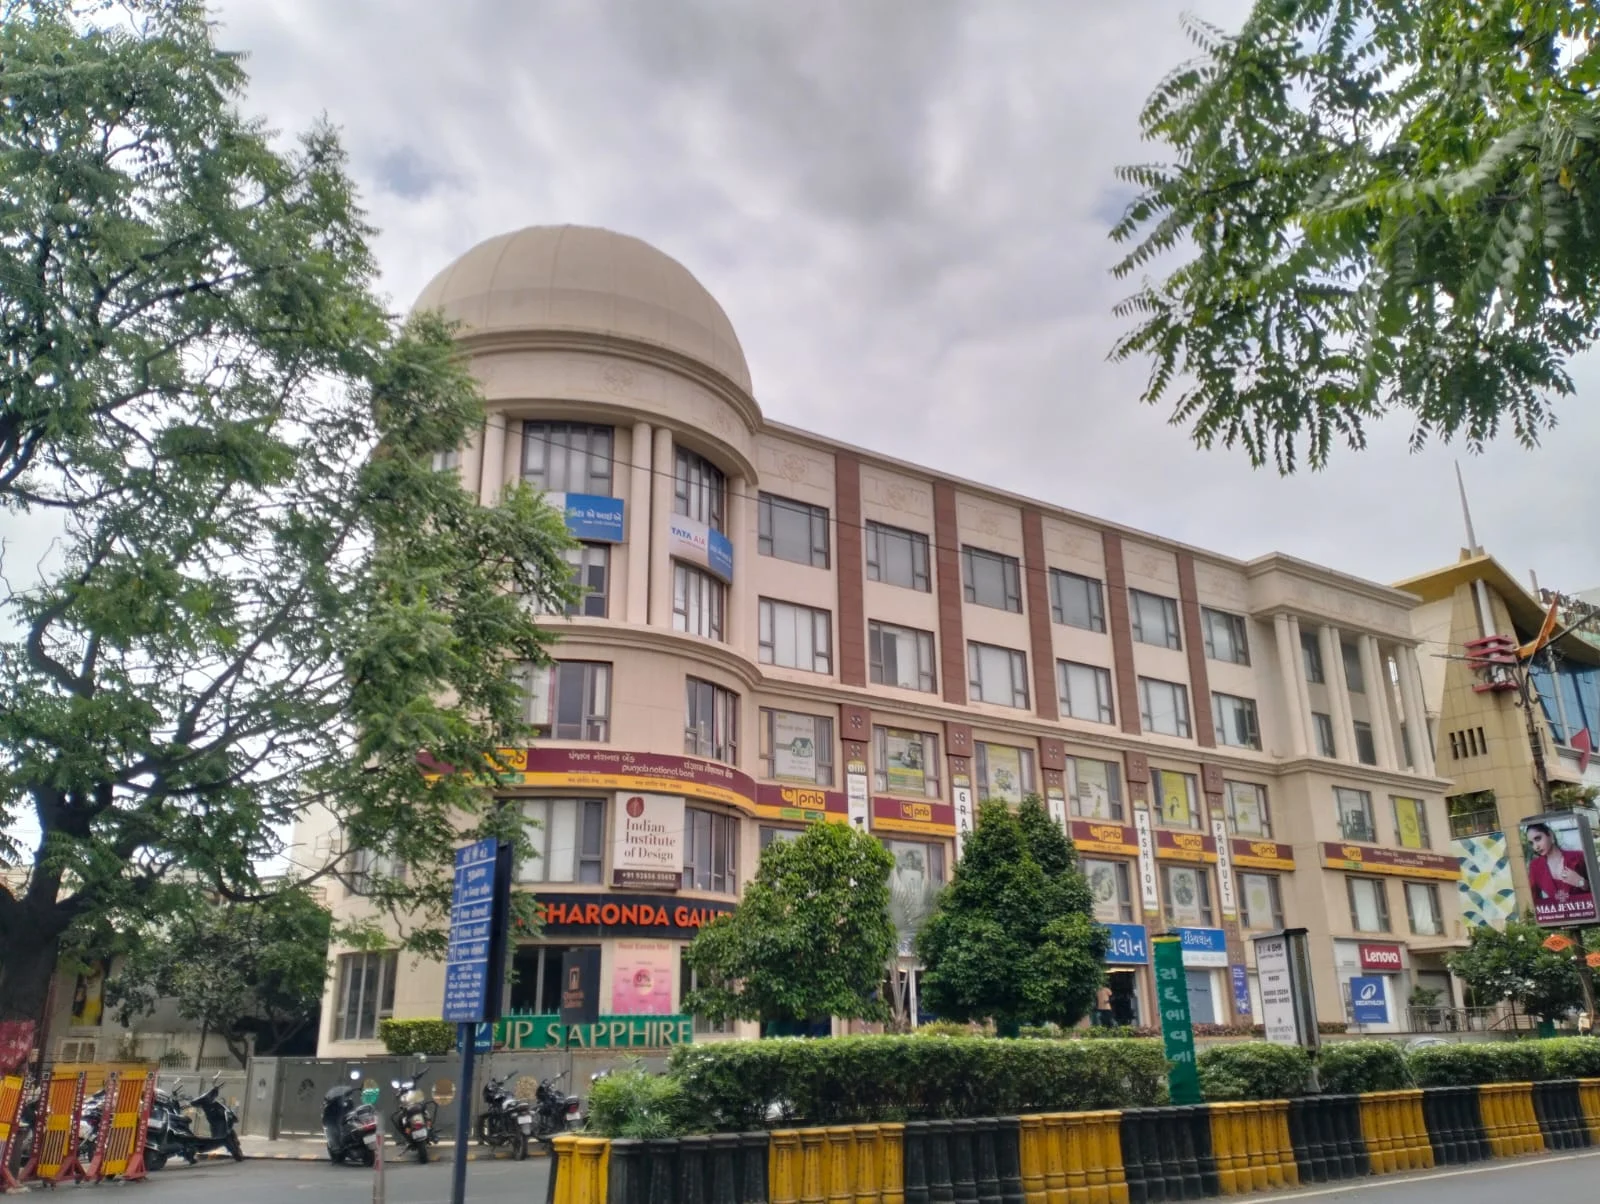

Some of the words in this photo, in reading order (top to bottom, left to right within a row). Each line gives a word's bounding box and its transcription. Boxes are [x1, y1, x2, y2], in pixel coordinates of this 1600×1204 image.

[671, 526, 692, 541] TATA
[621, 763, 649, 775] punjab
[650, 765, 678, 776] national
[679, 768, 695, 779] bank
[799, 791, 824, 806] pnb
[914, 804, 930, 817] pnb
[626, 818, 665, 833] Indian
[625, 831, 676, 846] Institute
[1103, 829, 1121, 840] pnb
[1185, 837, 1201, 848] pnb
[624, 846, 635, 858] of
[638, 847, 674, 863] Design
[1139, 814, 1153, 896] FASHION
[1261, 846, 1276, 856] pnb
[1216, 823, 1230, 902] PRODUCT
[1536, 903, 1557, 914] MAA
[1558, 900, 1594, 912] JEWELS
[1364, 947, 1400, 963] Lenovo
[500, 1020, 533, 1050] JP
[545, 1019, 690, 1049] SAPPHIRE
